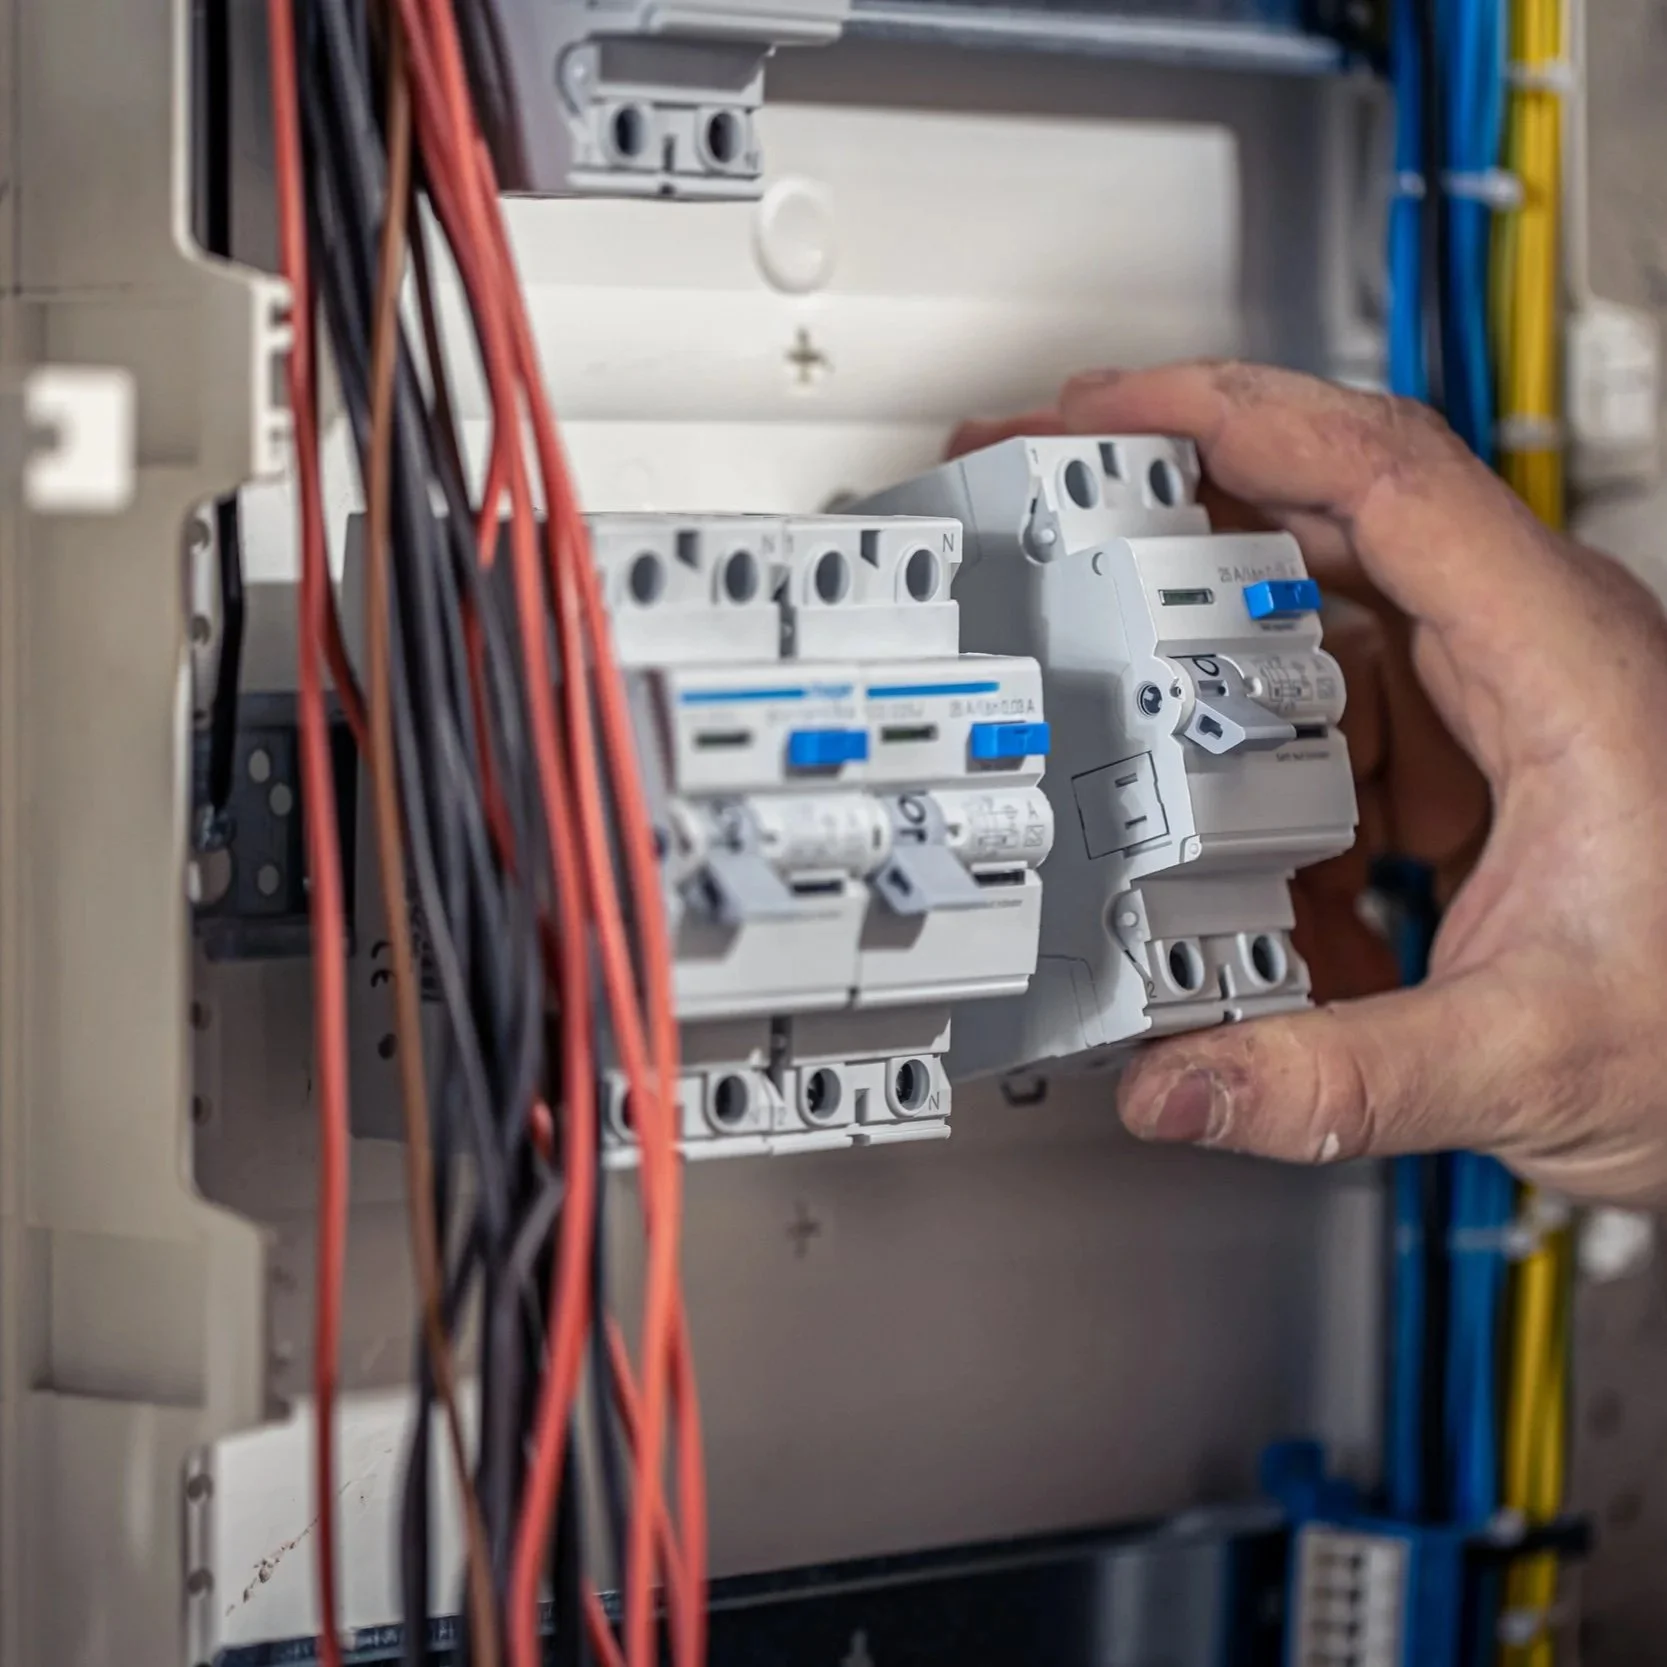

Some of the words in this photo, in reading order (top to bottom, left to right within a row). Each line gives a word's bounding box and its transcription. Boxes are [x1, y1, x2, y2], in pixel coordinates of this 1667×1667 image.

[941, 532, 956, 553] N
[1145, 979, 1159, 999] 2
[927, 1090, 940, 1112] N
